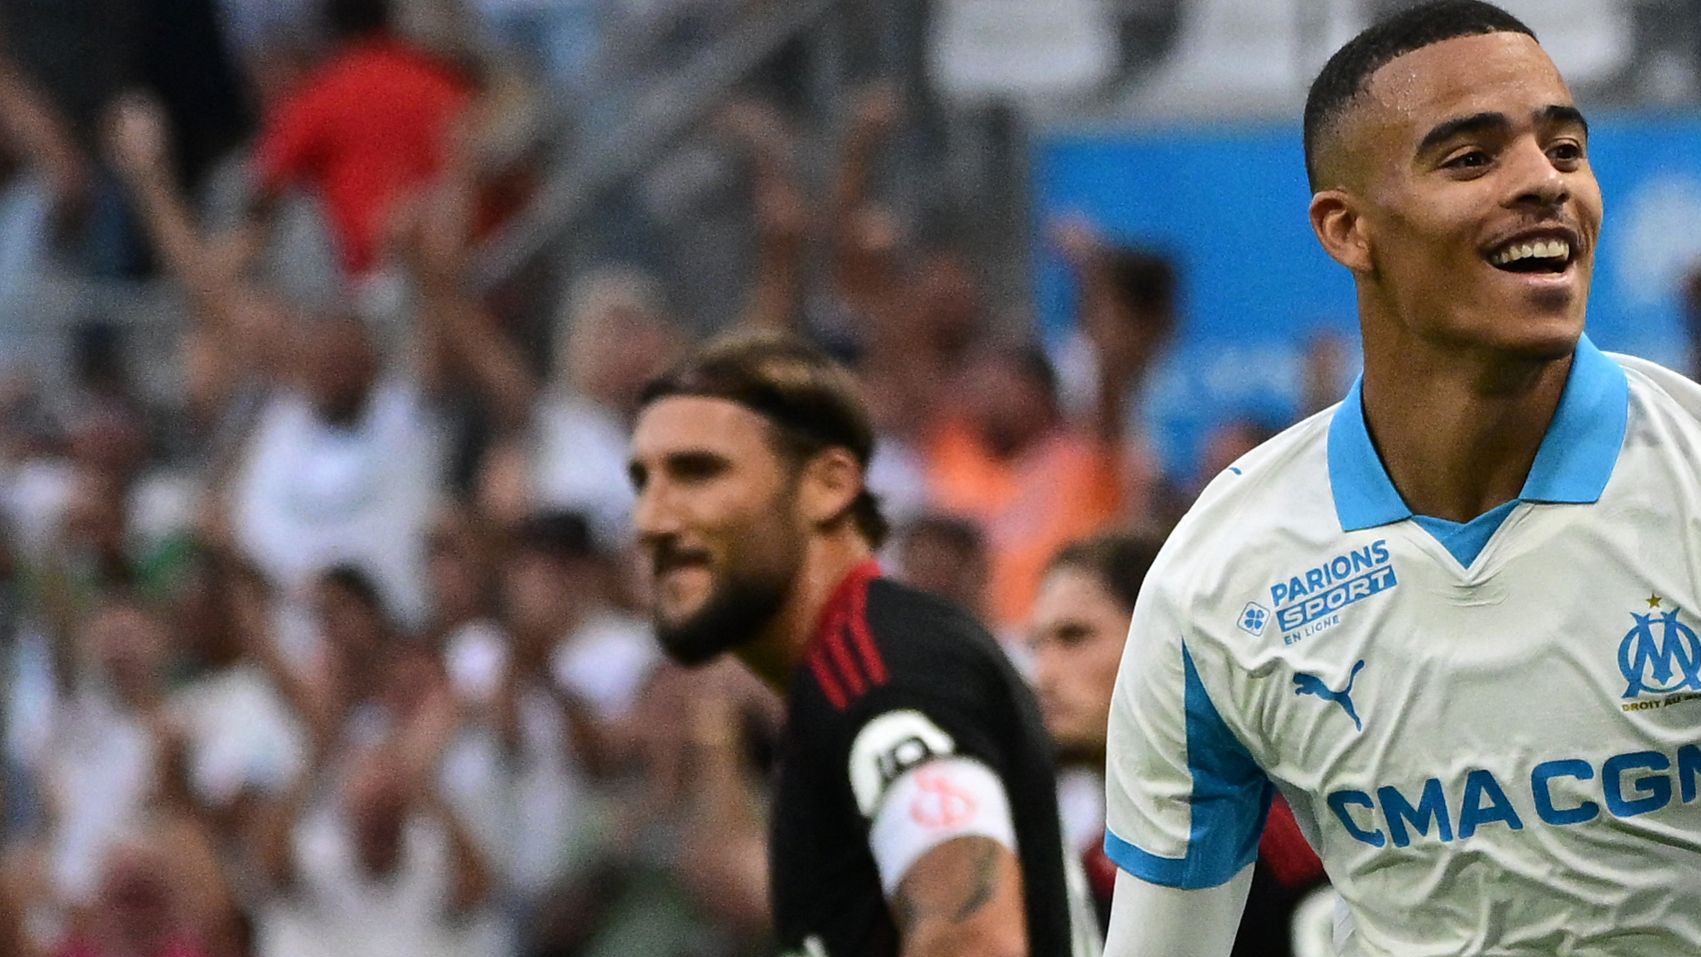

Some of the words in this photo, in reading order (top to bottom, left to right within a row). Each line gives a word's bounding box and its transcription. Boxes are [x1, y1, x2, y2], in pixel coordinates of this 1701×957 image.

[1270, 539, 1390, 607] PARIONS
[1283, 566, 1392, 630] SPORT
[1284, 633, 1302, 646] EN
[1305, 614, 1341, 638] LIGNE
[1621, 699, 1662, 712] DROIT
[1327, 768, 1524, 849] CMA
